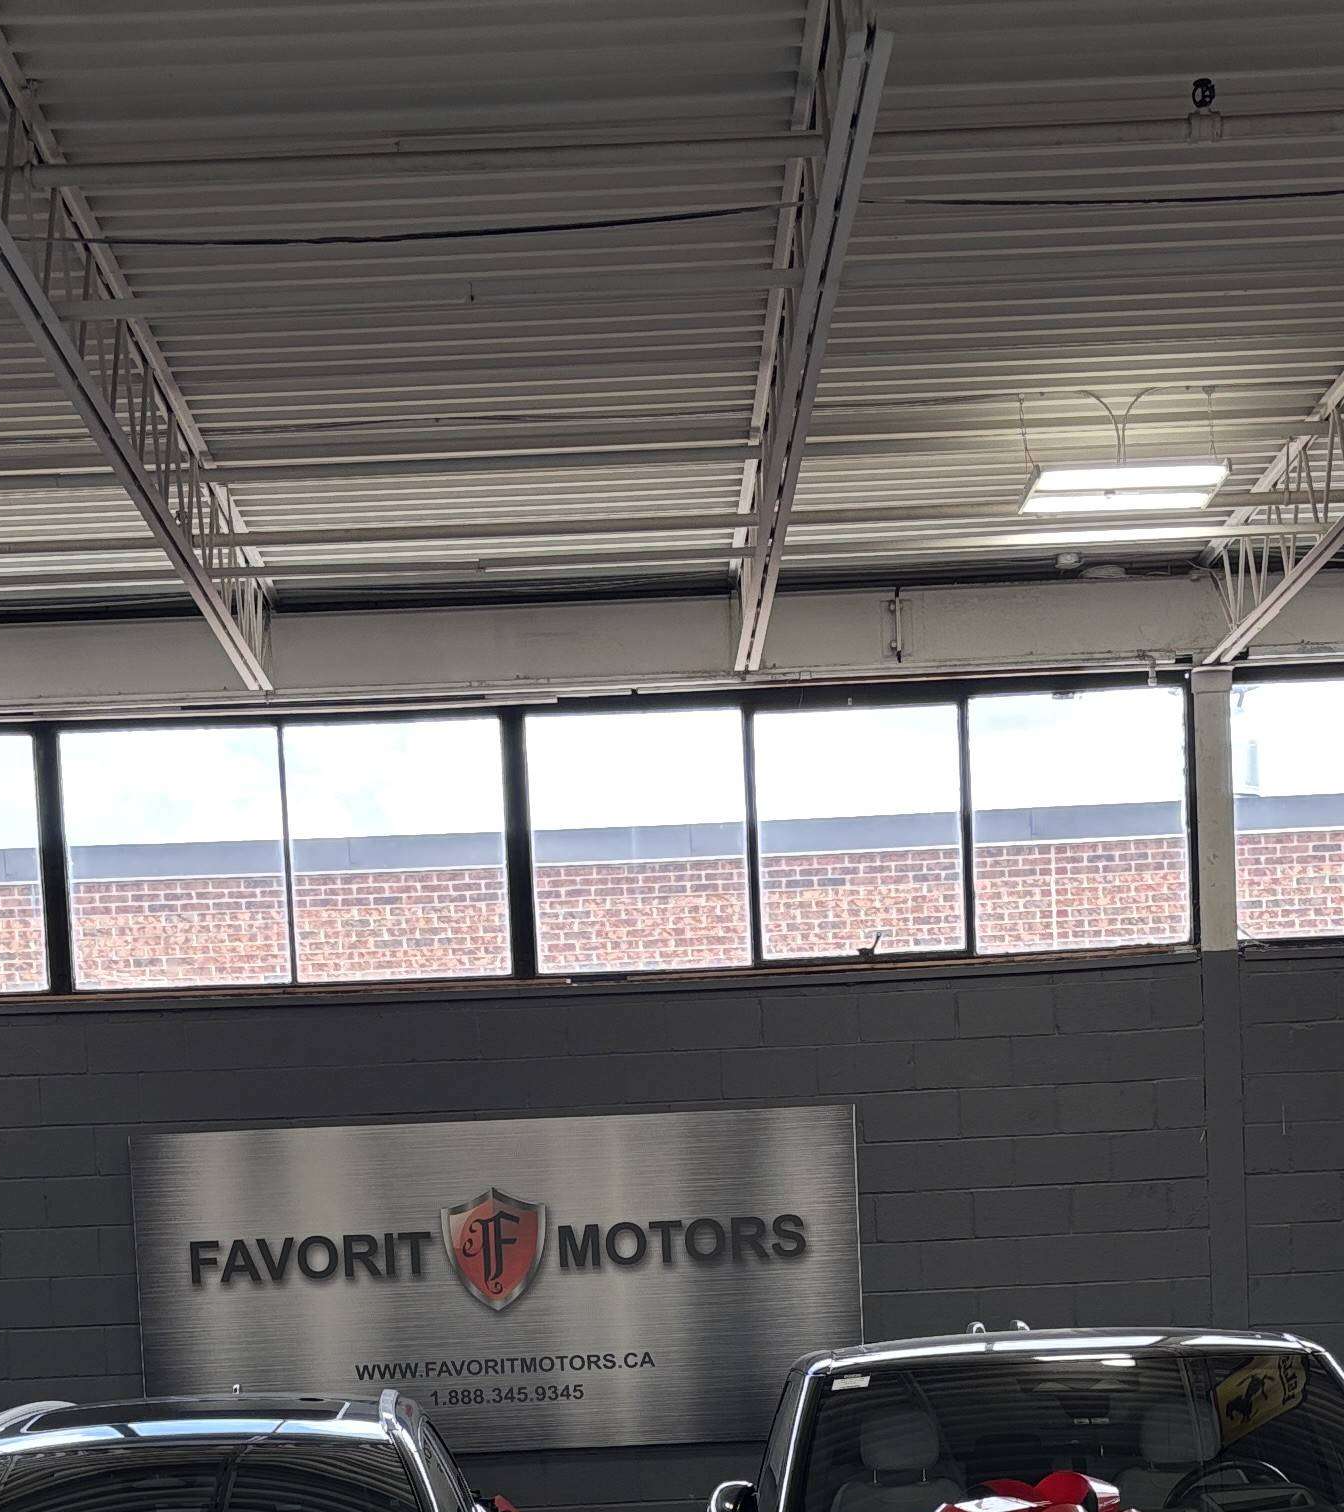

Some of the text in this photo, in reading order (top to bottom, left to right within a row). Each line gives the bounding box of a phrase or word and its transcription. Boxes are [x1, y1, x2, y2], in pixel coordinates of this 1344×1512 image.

[190, 1231, 431, 1284] FAVORIT
[558, 1214, 806, 1268] MOTORS
[355, 1351, 656, 1380] WWW.FAVORITMOTORS.CA
[430, 1384, 584, 1406] 1.888.345.9345
